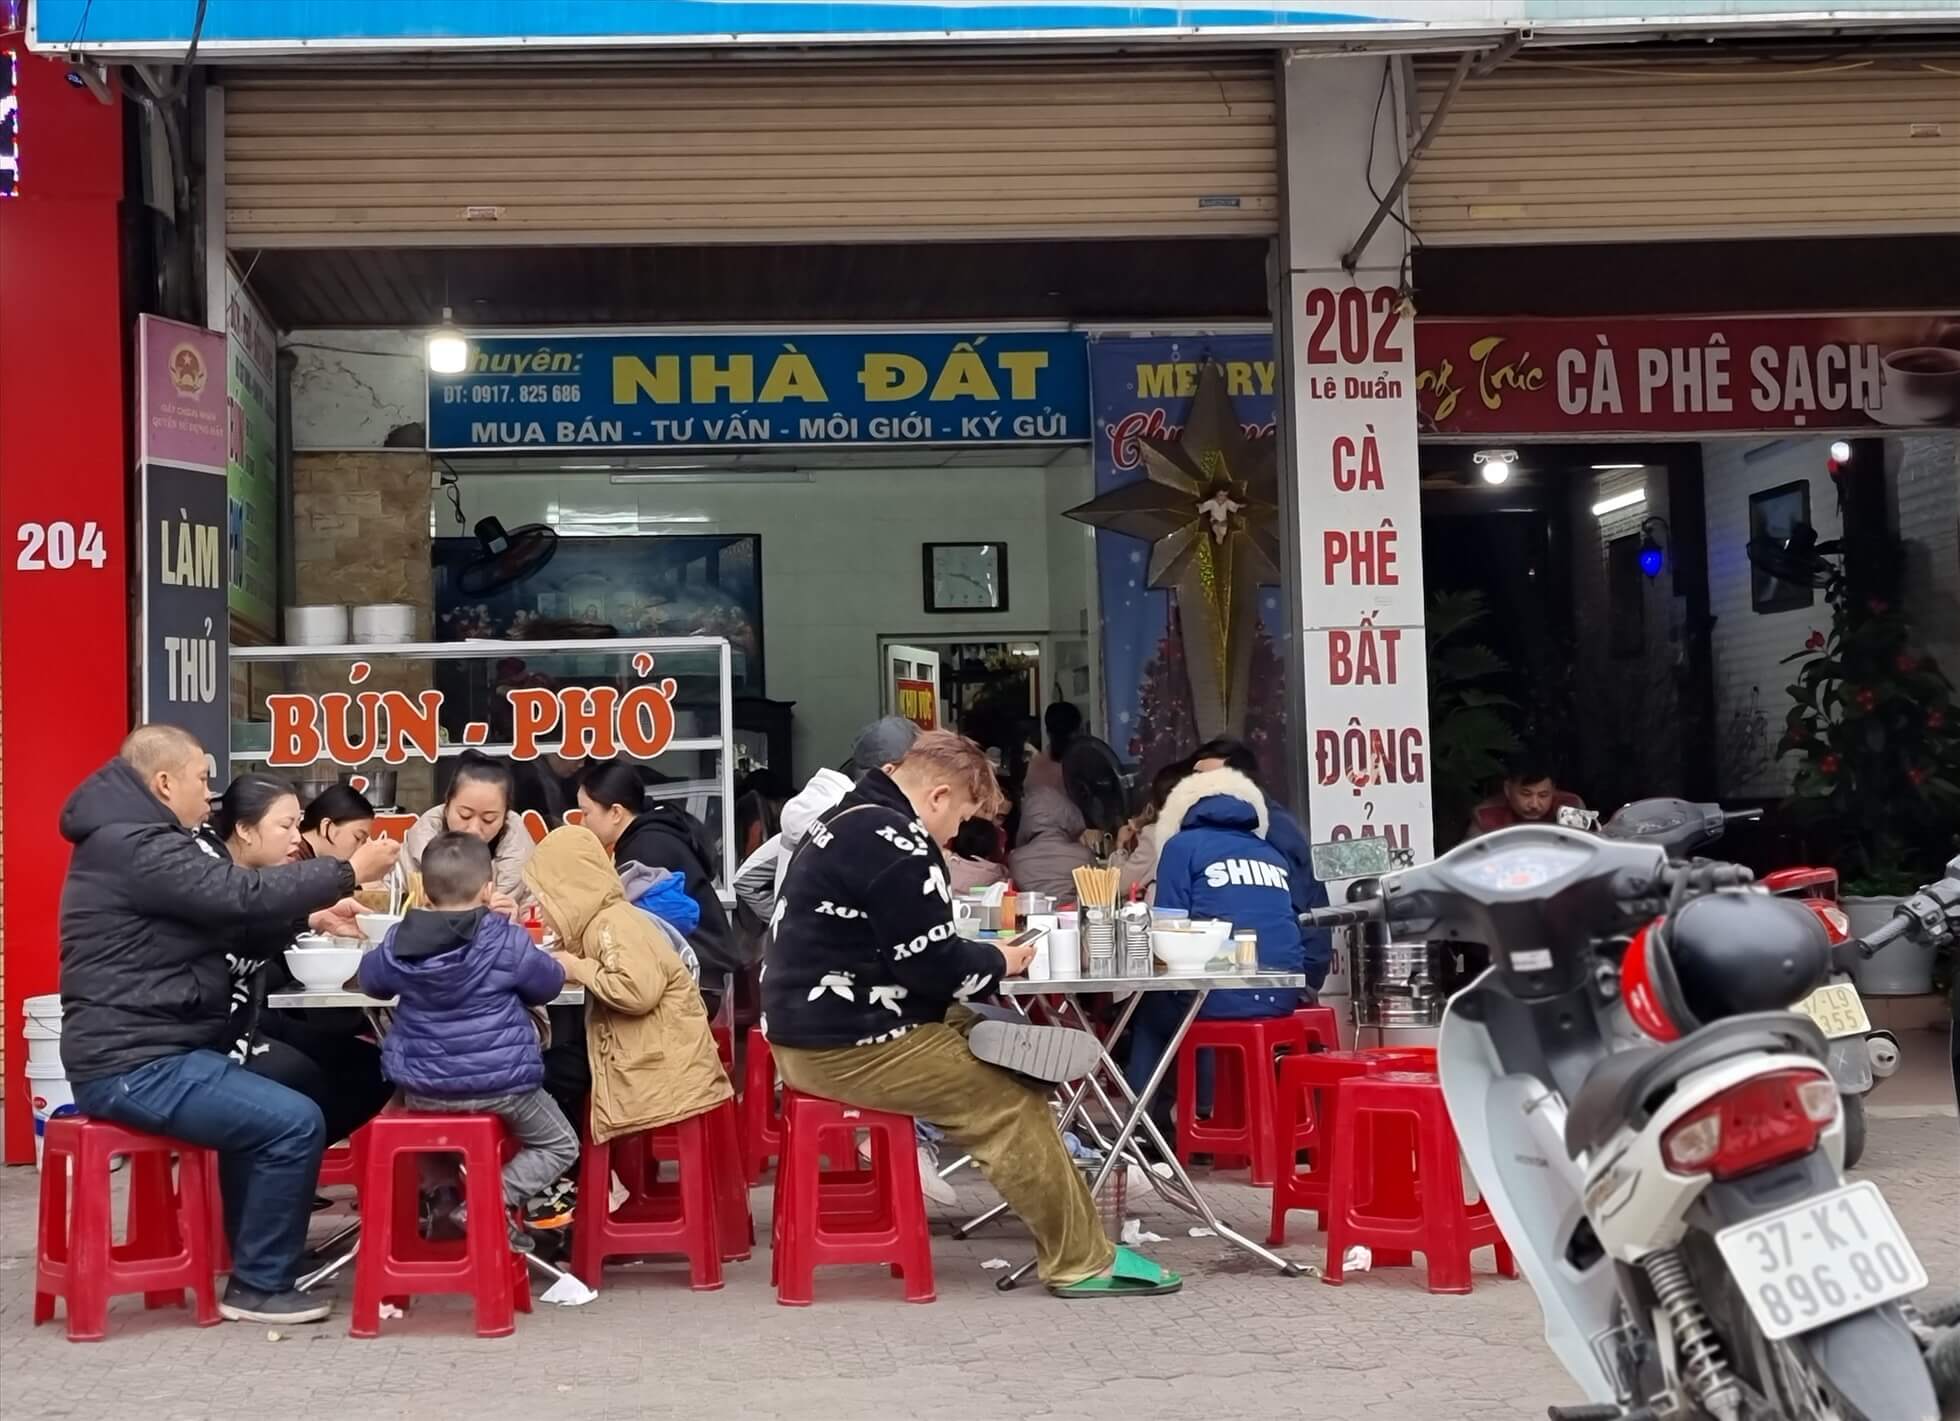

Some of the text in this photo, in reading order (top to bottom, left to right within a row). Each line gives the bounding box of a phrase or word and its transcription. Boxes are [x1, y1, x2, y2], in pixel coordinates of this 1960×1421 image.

[1306, 286, 1403, 364] 202
[466, 346, 584, 377] huyên:
[472, 385, 515, 403] 0917.
[519, 384, 548, 403] 825
[552, 384, 581, 403] 686
[613, 336, 1049, 405] NHÀ ĐẤT
[1136, 361, 1276, 399] MERY
[1310, 370, 1403, 400] Lê Duẩn
[1469, 336, 1548, 409] Trúc
[1557, 332, 1883, 426] CÀ PHÊ SẠCH
[471, 421, 547, 443] MUA
[556, 415, 623, 442] BÁN
[651, 417, 695, 441] TƯ
[703, 410, 770, 441] VẤN
[799, 411, 858, 439] MÔI
[868, 411, 932, 439] GIỚI
[961, 410, 1002, 438] KÝ
[1013, 406, 1067, 438] GỬI
[1332, 424, 1385, 492] CÀ
[16, 521, 107, 571] 204
[160, 507, 219, 589] LÀM
[1323, 518, 1399, 586] PHÊ
[164, 616, 217, 704] THỦ
[1328, 610, 1402, 686] BẤT
[265, 661, 444, 767] BÚN
[506, 652, 678, 762] PHỞ
[1315, 717, 1425, 796] ĐỘNG
[1820, 1010, 1858, 1034] 355
[1745, 1198, 1869, 1274] 37-K1
[1759, 1241, 1910, 1327] 896.80
